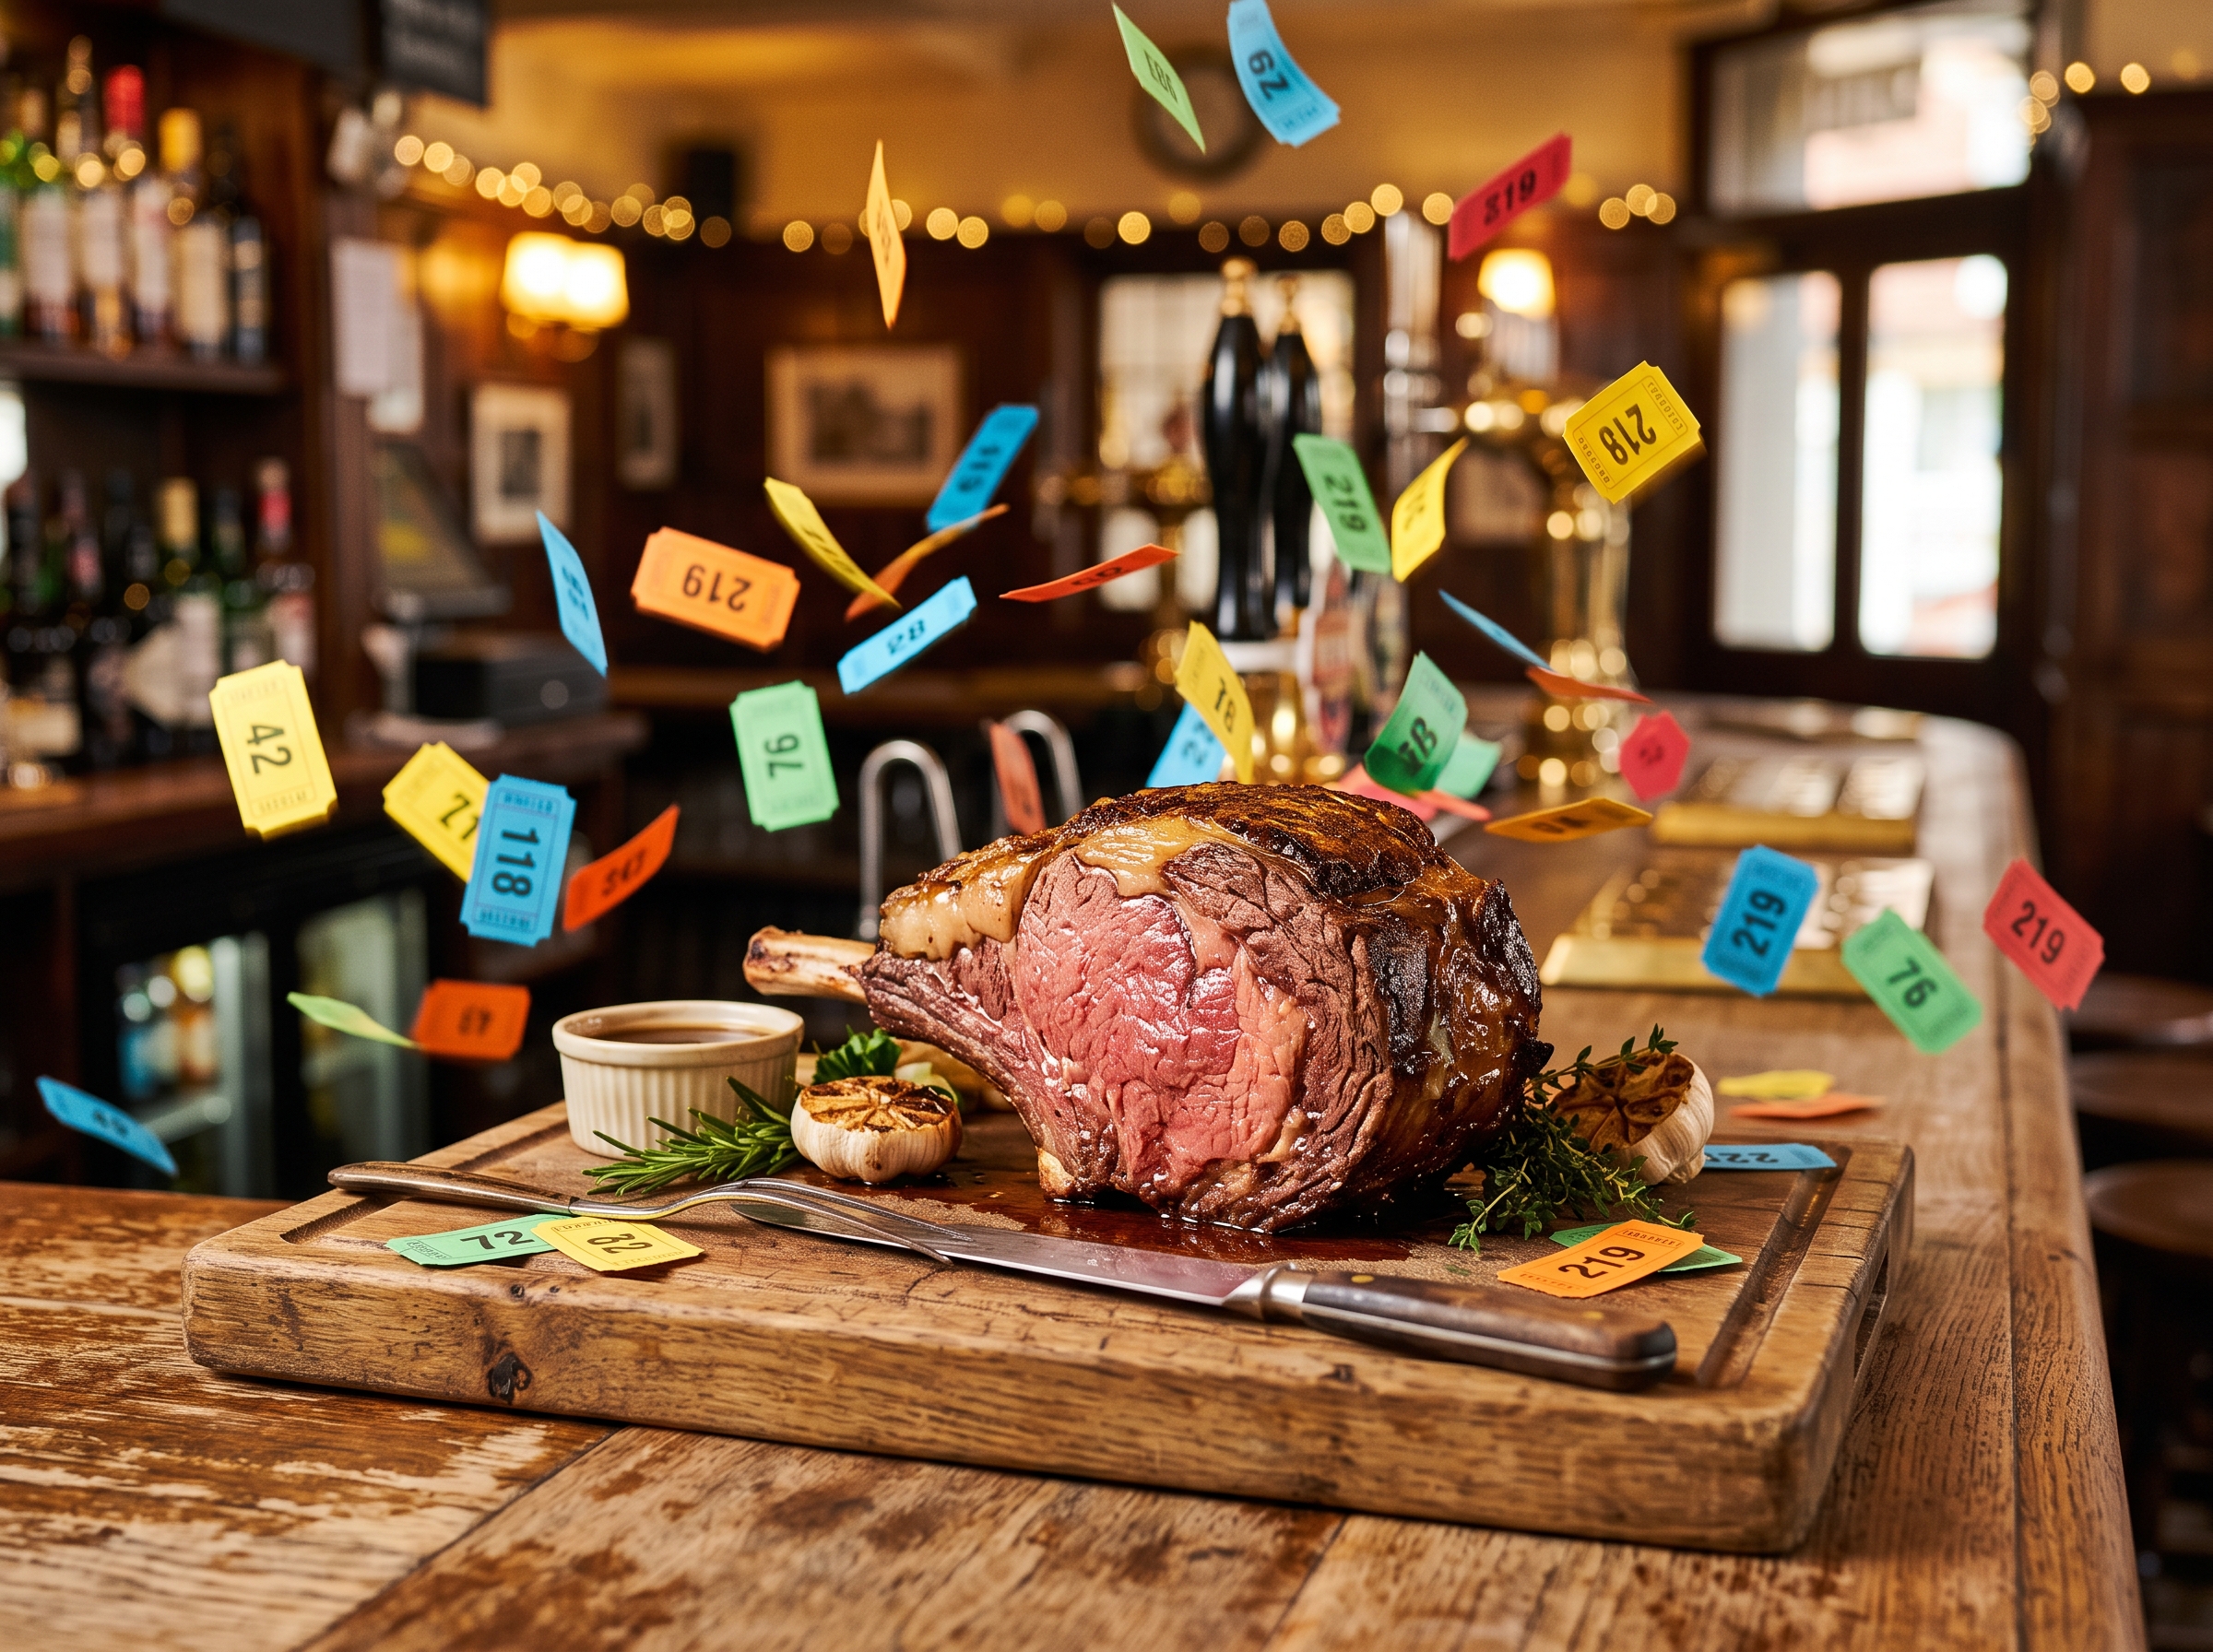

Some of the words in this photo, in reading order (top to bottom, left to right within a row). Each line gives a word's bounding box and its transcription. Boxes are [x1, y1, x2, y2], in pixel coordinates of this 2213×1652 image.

[1599, 403, 1656, 466] 218
[1324, 474, 1366, 533] 219
[682, 563, 751, 612] 219
[247, 724, 291, 774] 42
[763, 733, 804, 779] 76
[491, 828, 540, 898] 118
[1732, 891, 1785, 956] 219
[2010, 901, 2065, 964] 219
[1886, 961, 1937, 1008] 76
[459, 1230, 536, 1250] 72
[1558, 1245, 1645, 1280] 219
